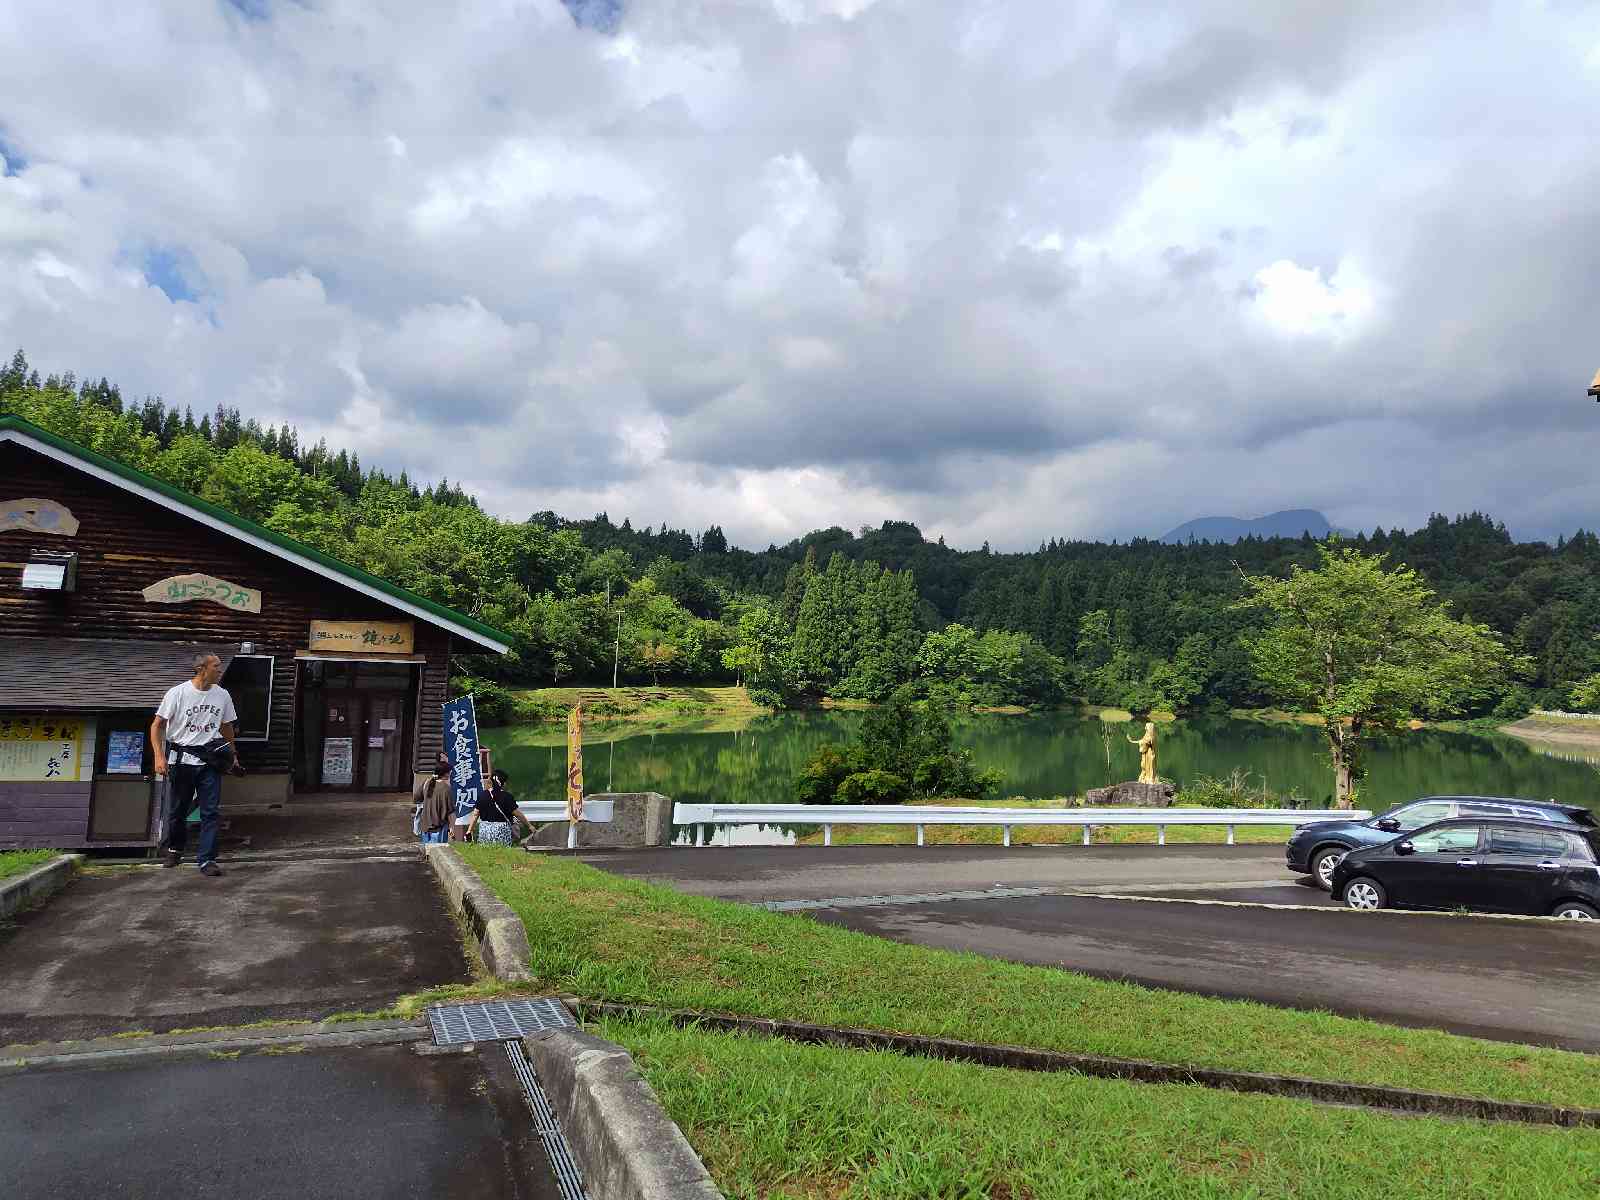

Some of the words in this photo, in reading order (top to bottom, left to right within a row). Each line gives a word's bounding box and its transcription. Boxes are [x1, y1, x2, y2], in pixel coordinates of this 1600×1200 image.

[185, 704, 221, 717] COFFEE
[184, 719, 218, 733] POWER
[449, 709, 478, 815] お食事処
